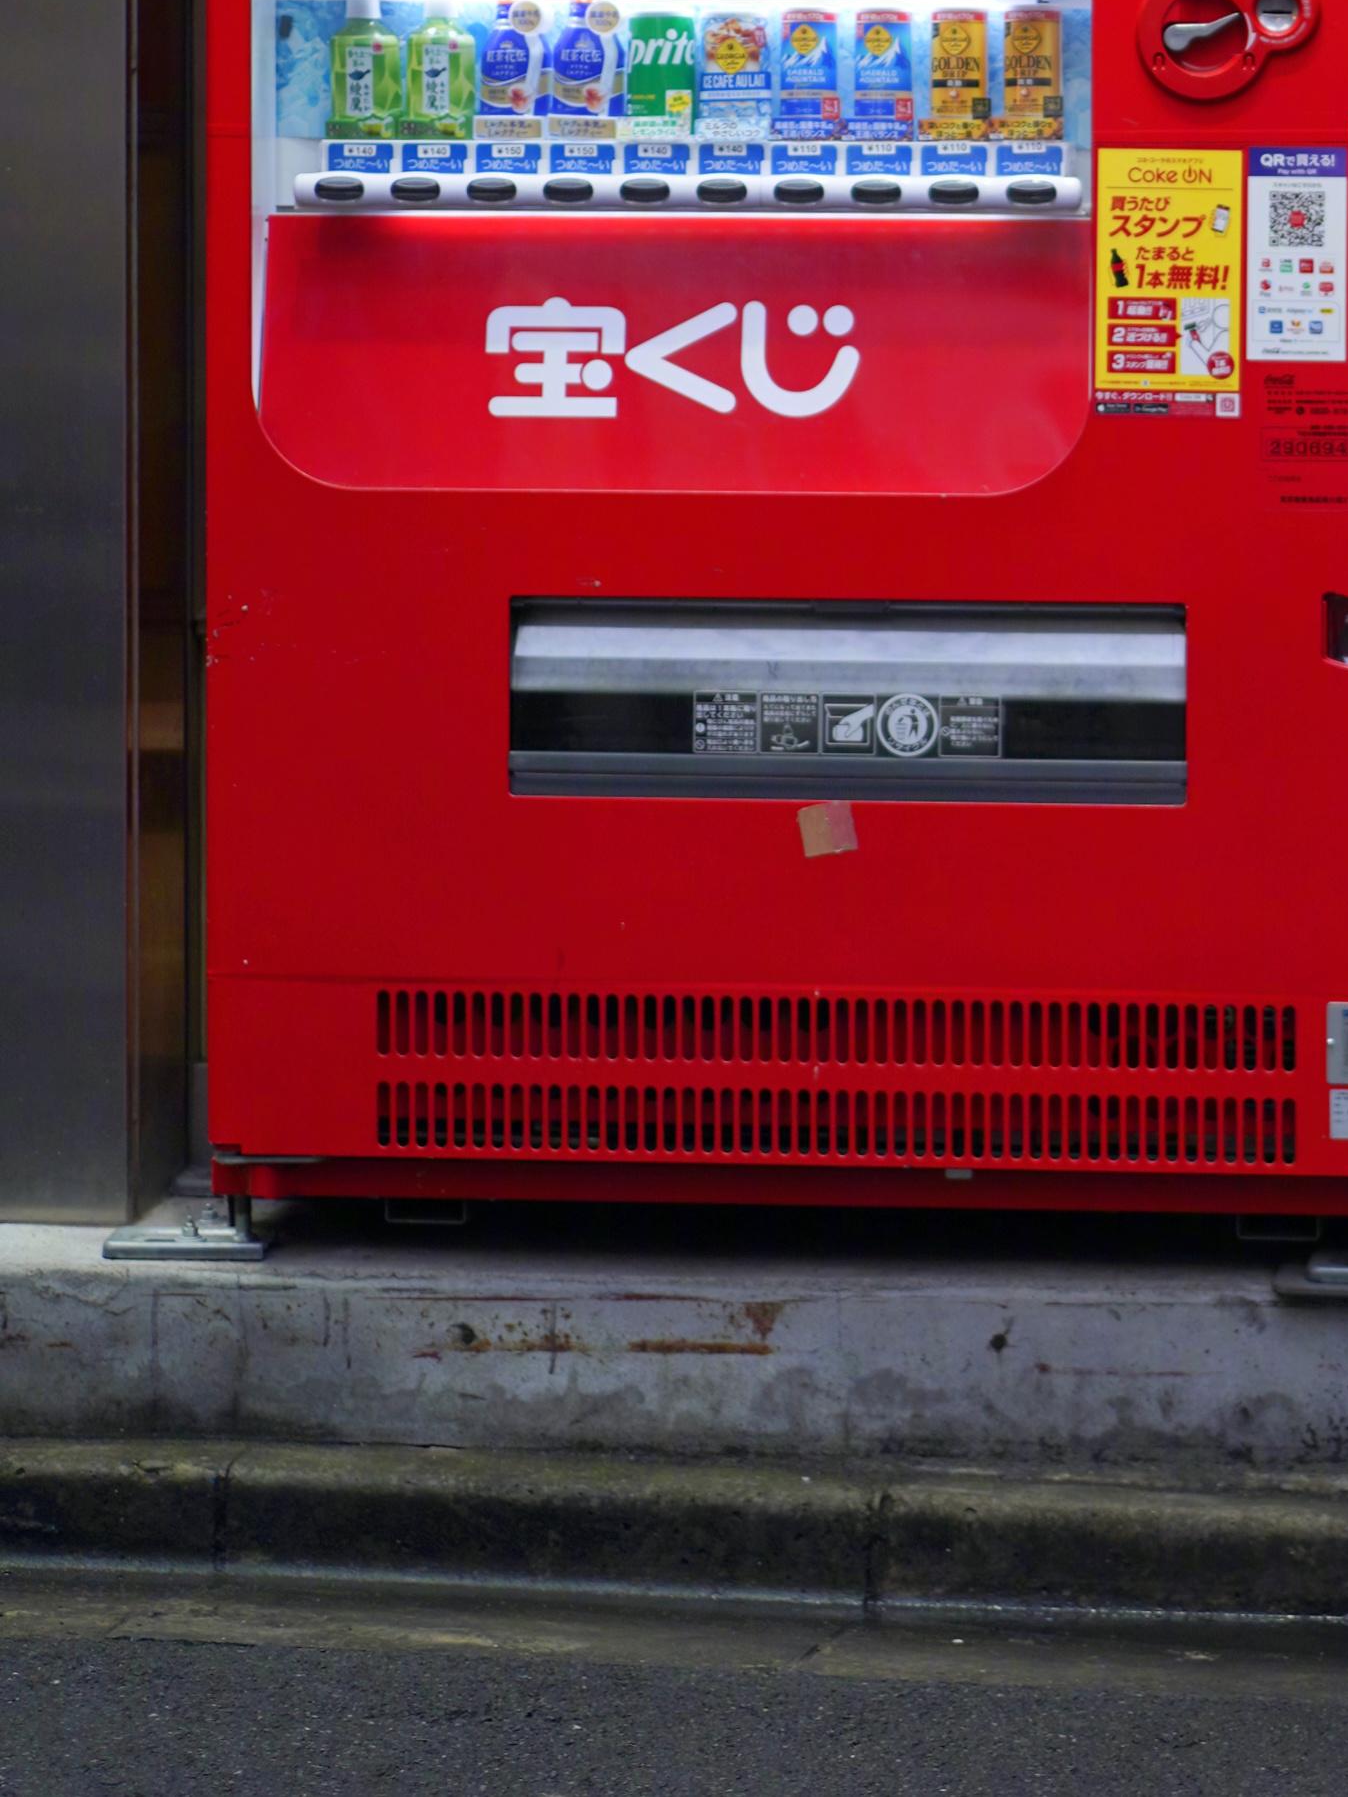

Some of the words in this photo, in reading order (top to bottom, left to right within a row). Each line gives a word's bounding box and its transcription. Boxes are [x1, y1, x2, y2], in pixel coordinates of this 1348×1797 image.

[931, 56, 980, 72] GOLDEN
[703, 122, 738, 131] ミルクの
[1127, 167, 1178, 184] Coke
[1110, 195, 1171, 212] 買うたび
[1108, 214, 1207, 239] スタンプ
[1135, 245, 1195, 262] たまると
[1111, 326, 1126, 343] 2
[485, 296, 861, 419] 宝くじ
[1111, 353, 1126, 370] 3
